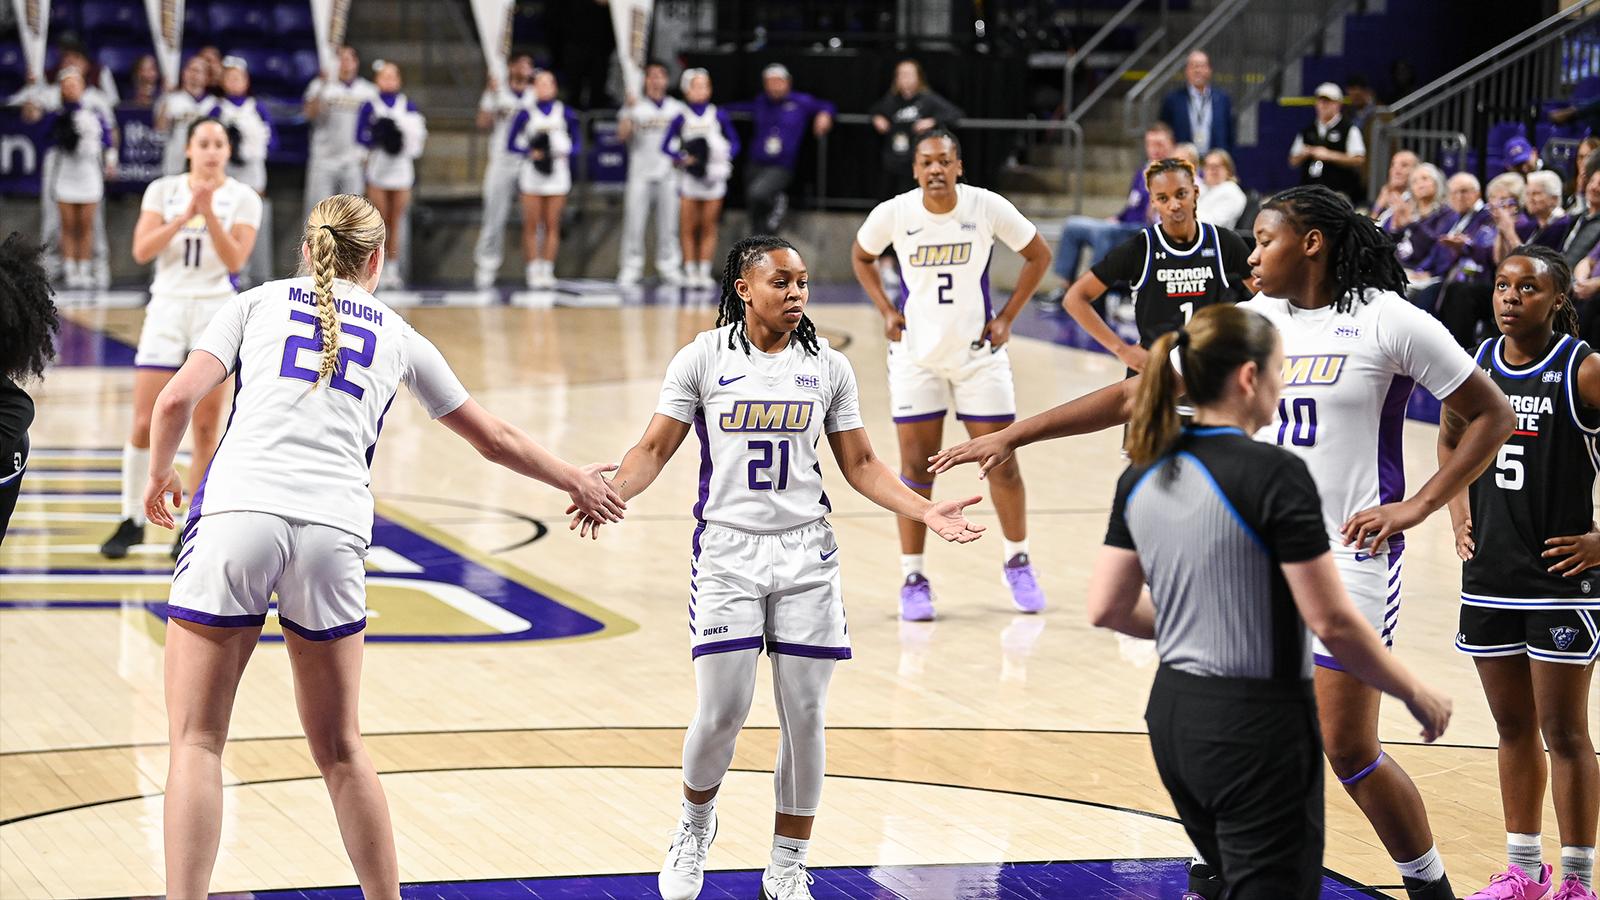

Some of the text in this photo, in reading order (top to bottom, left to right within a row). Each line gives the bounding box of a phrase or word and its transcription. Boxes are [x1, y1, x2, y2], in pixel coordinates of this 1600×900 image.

[184, 238, 202, 267] 11
[909, 242, 971, 267] JMU
[937, 273, 953, 304] 2
[1156, 266, 1214, 282] GEORGIA
[1166, 279, 1207, 293] STATE
[288, 287, 383, 327] McDNOUGH
[1179, 302, 1193, 327] 1
[280, 309, 377, 401] 22
[1281, 354, 1347, 387] MU
[719, 400, 815, 433] JMU
[1506, 395, 1553, 415] RGIA
[1277, 398, 1318, 447] 10
[747, 440, 790, 490] 21
[1495, 443, 1525, 491] 5
[703, 625, 729, 637] DUKES
